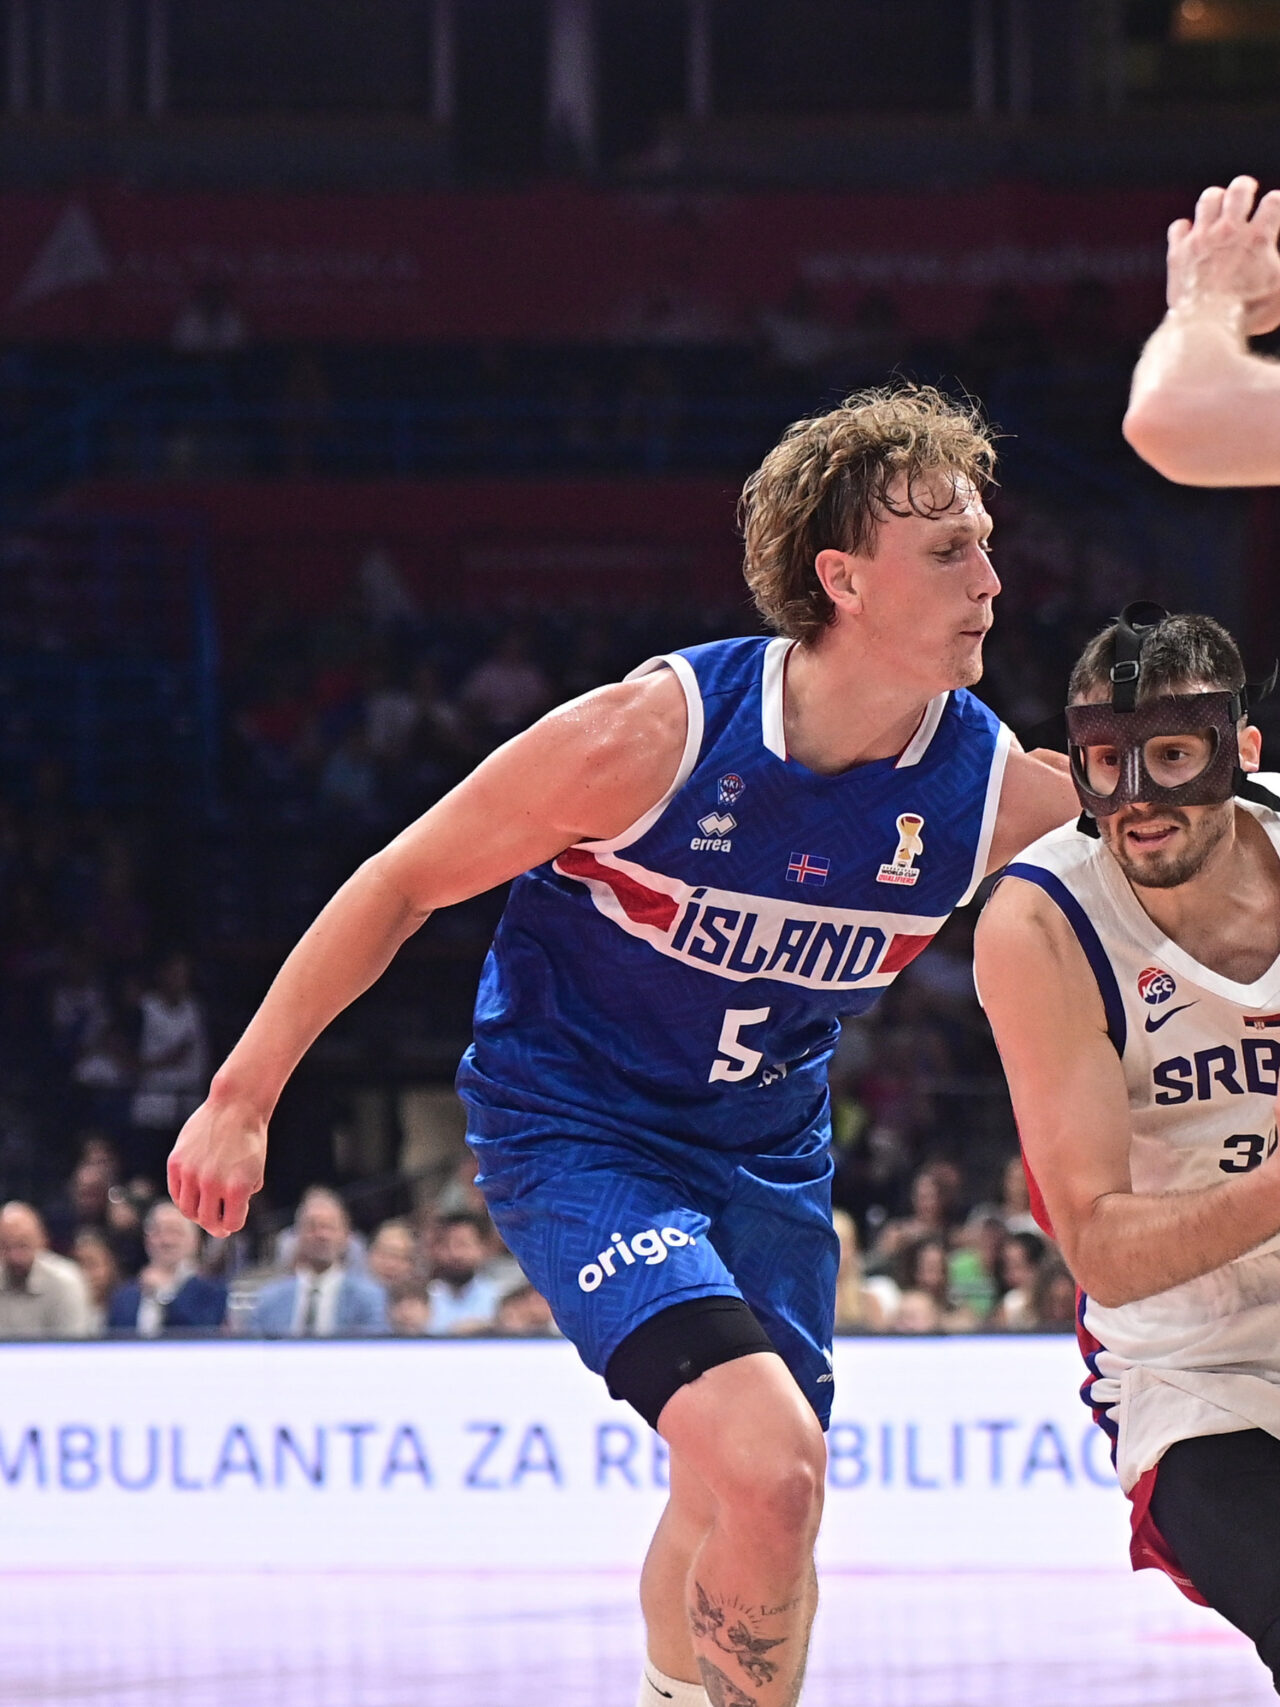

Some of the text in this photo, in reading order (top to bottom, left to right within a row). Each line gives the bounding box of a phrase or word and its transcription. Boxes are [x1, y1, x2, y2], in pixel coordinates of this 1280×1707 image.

[708, 1006, 771, 1083] 5
[1219, 1124, 1278, 1173] 3
[464, 1420, 564, 1490] ZA
